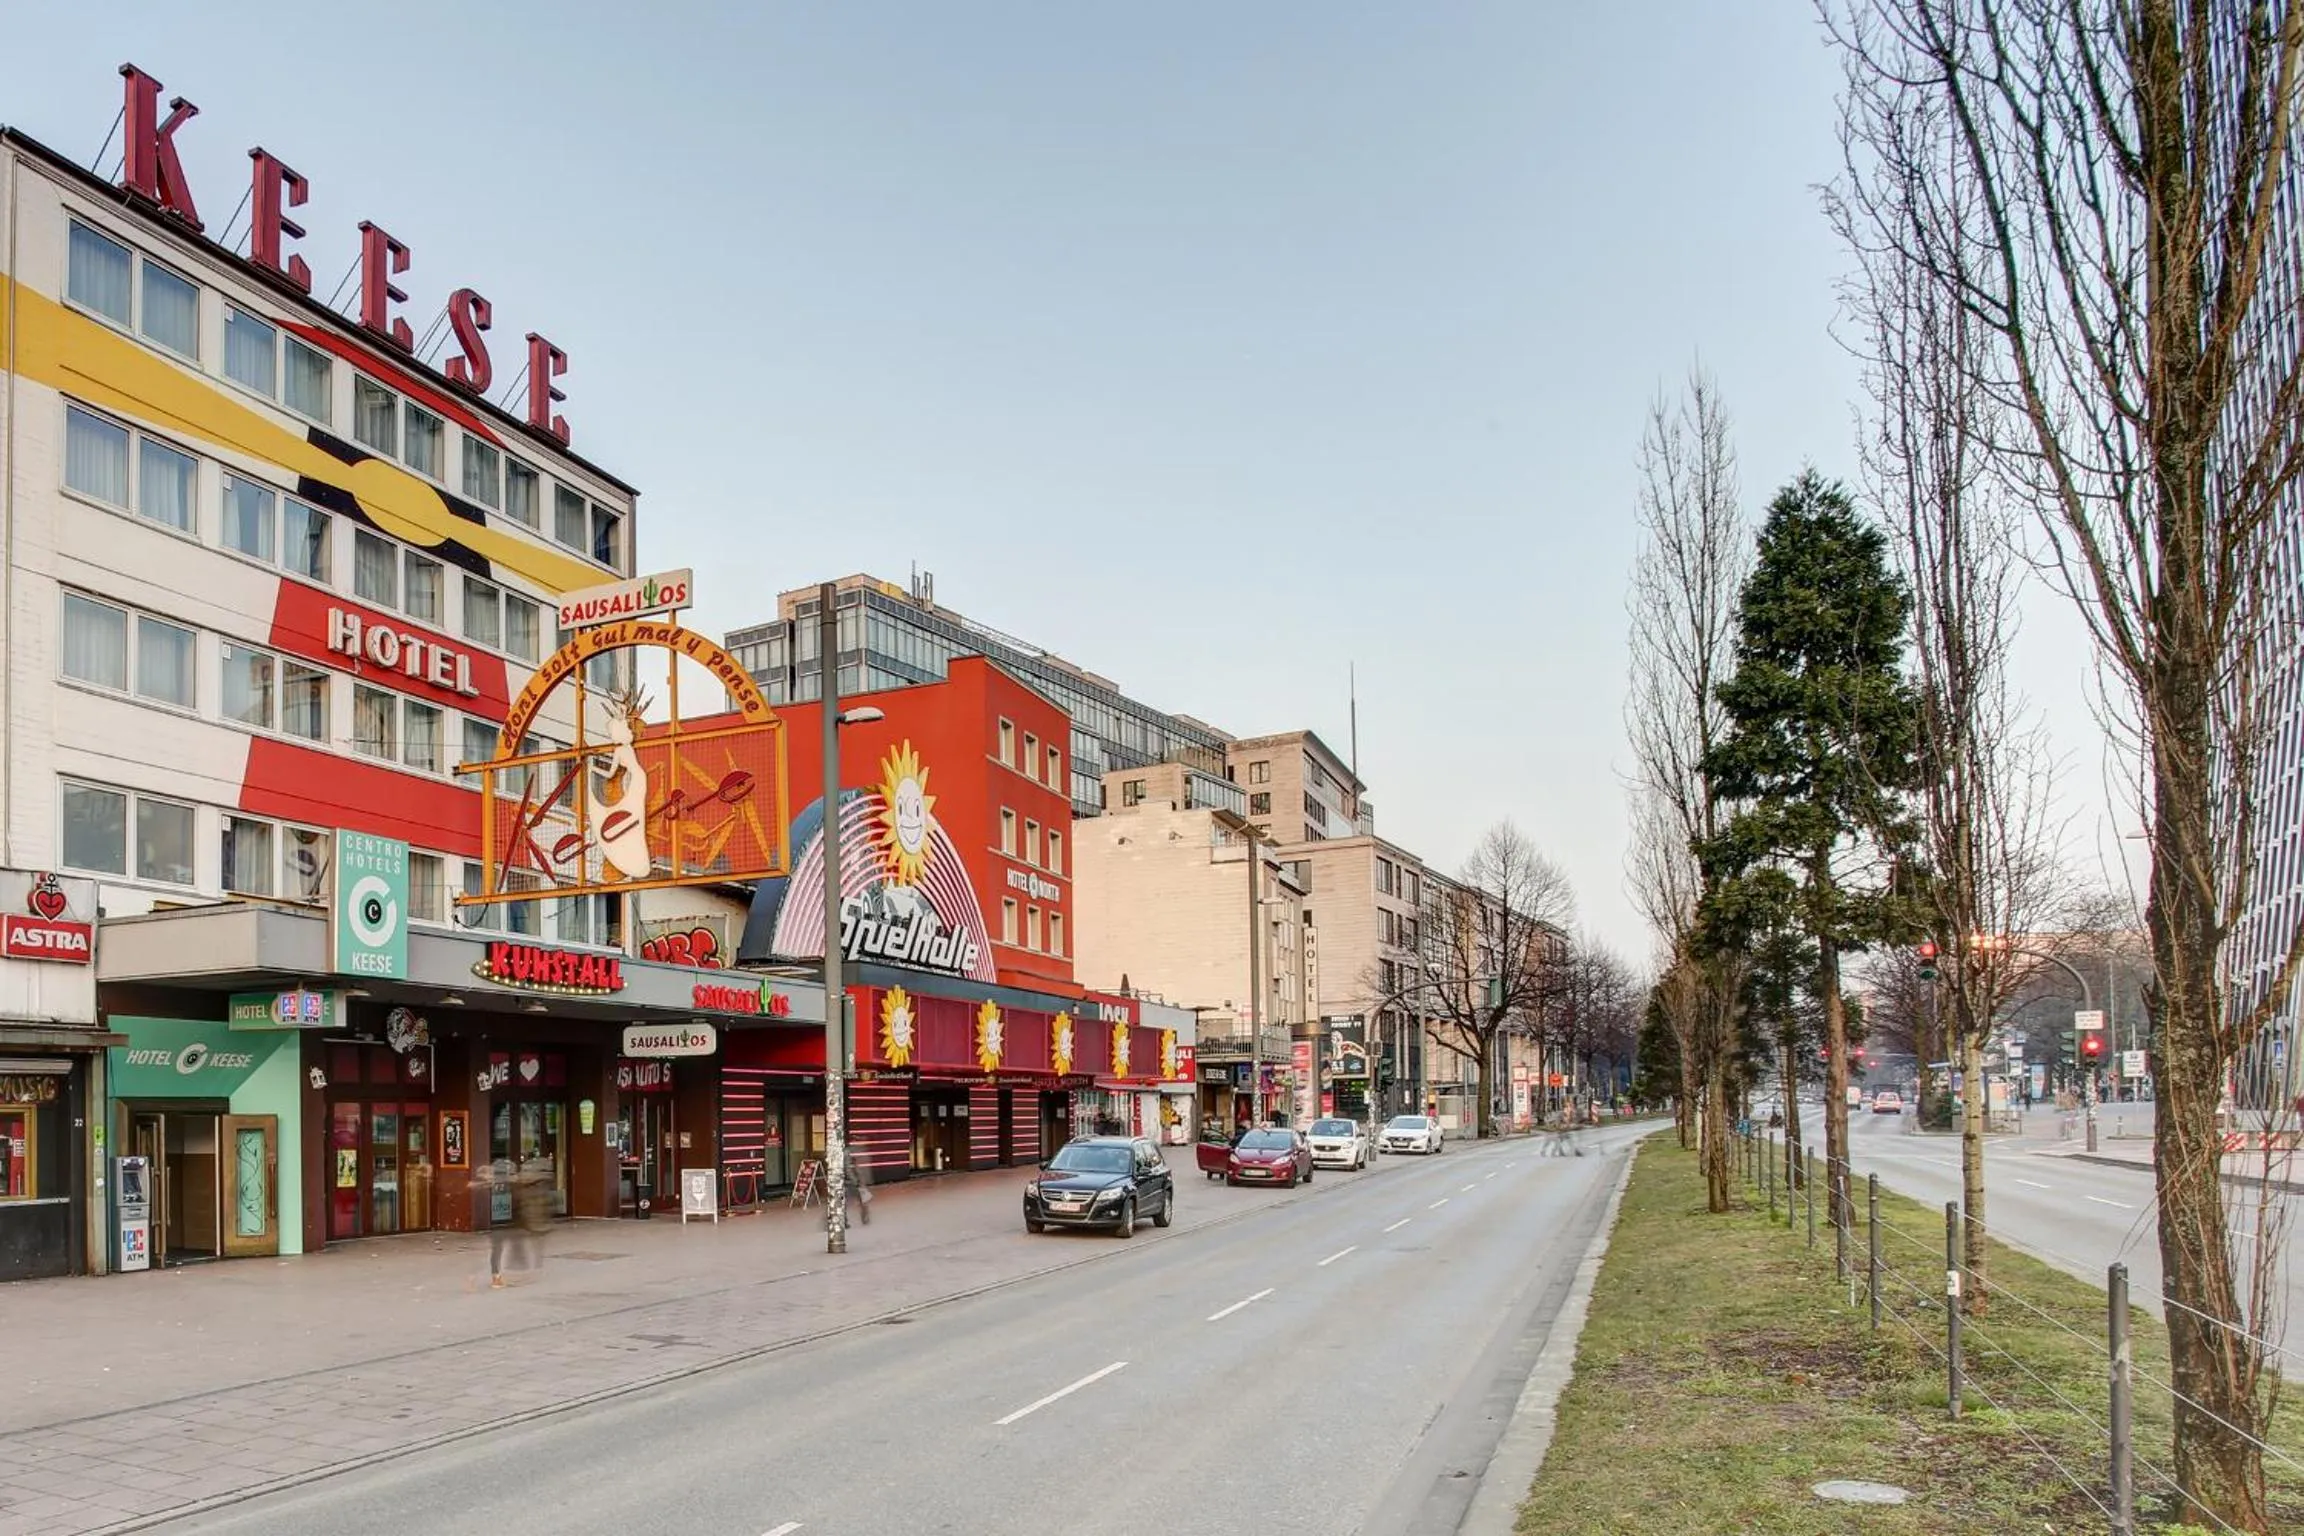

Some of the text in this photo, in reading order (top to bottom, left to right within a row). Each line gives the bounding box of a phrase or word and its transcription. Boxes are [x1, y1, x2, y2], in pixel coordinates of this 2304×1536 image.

[118, 62, 571, 448] KEESE
[328, 607, 480, 697] HOTEL
[632, 622, 681, 647] mal
[686, 637, 702, 656] y
[706, 649, 761, 715] pense
[346, 835, 402, 858] CENTRO
[346, 852, 401, 874] HOTELS
[1007, 867, 1029, 892] HOTEL
[10, 927, 89, 952] ASTRA
[352, 952, 393, 974] KEESE
[491, 941, 624, 990] KUHSTALL
[1306, 935, 1316, 1002] HOTEL
[235, 1005, 268, 1020] HOTEL
[126, 1049, 173, 1066] HOTEL
[210, 1053, 253, 1068] KEESE
[126, 1253, 145, 1262] ATM
